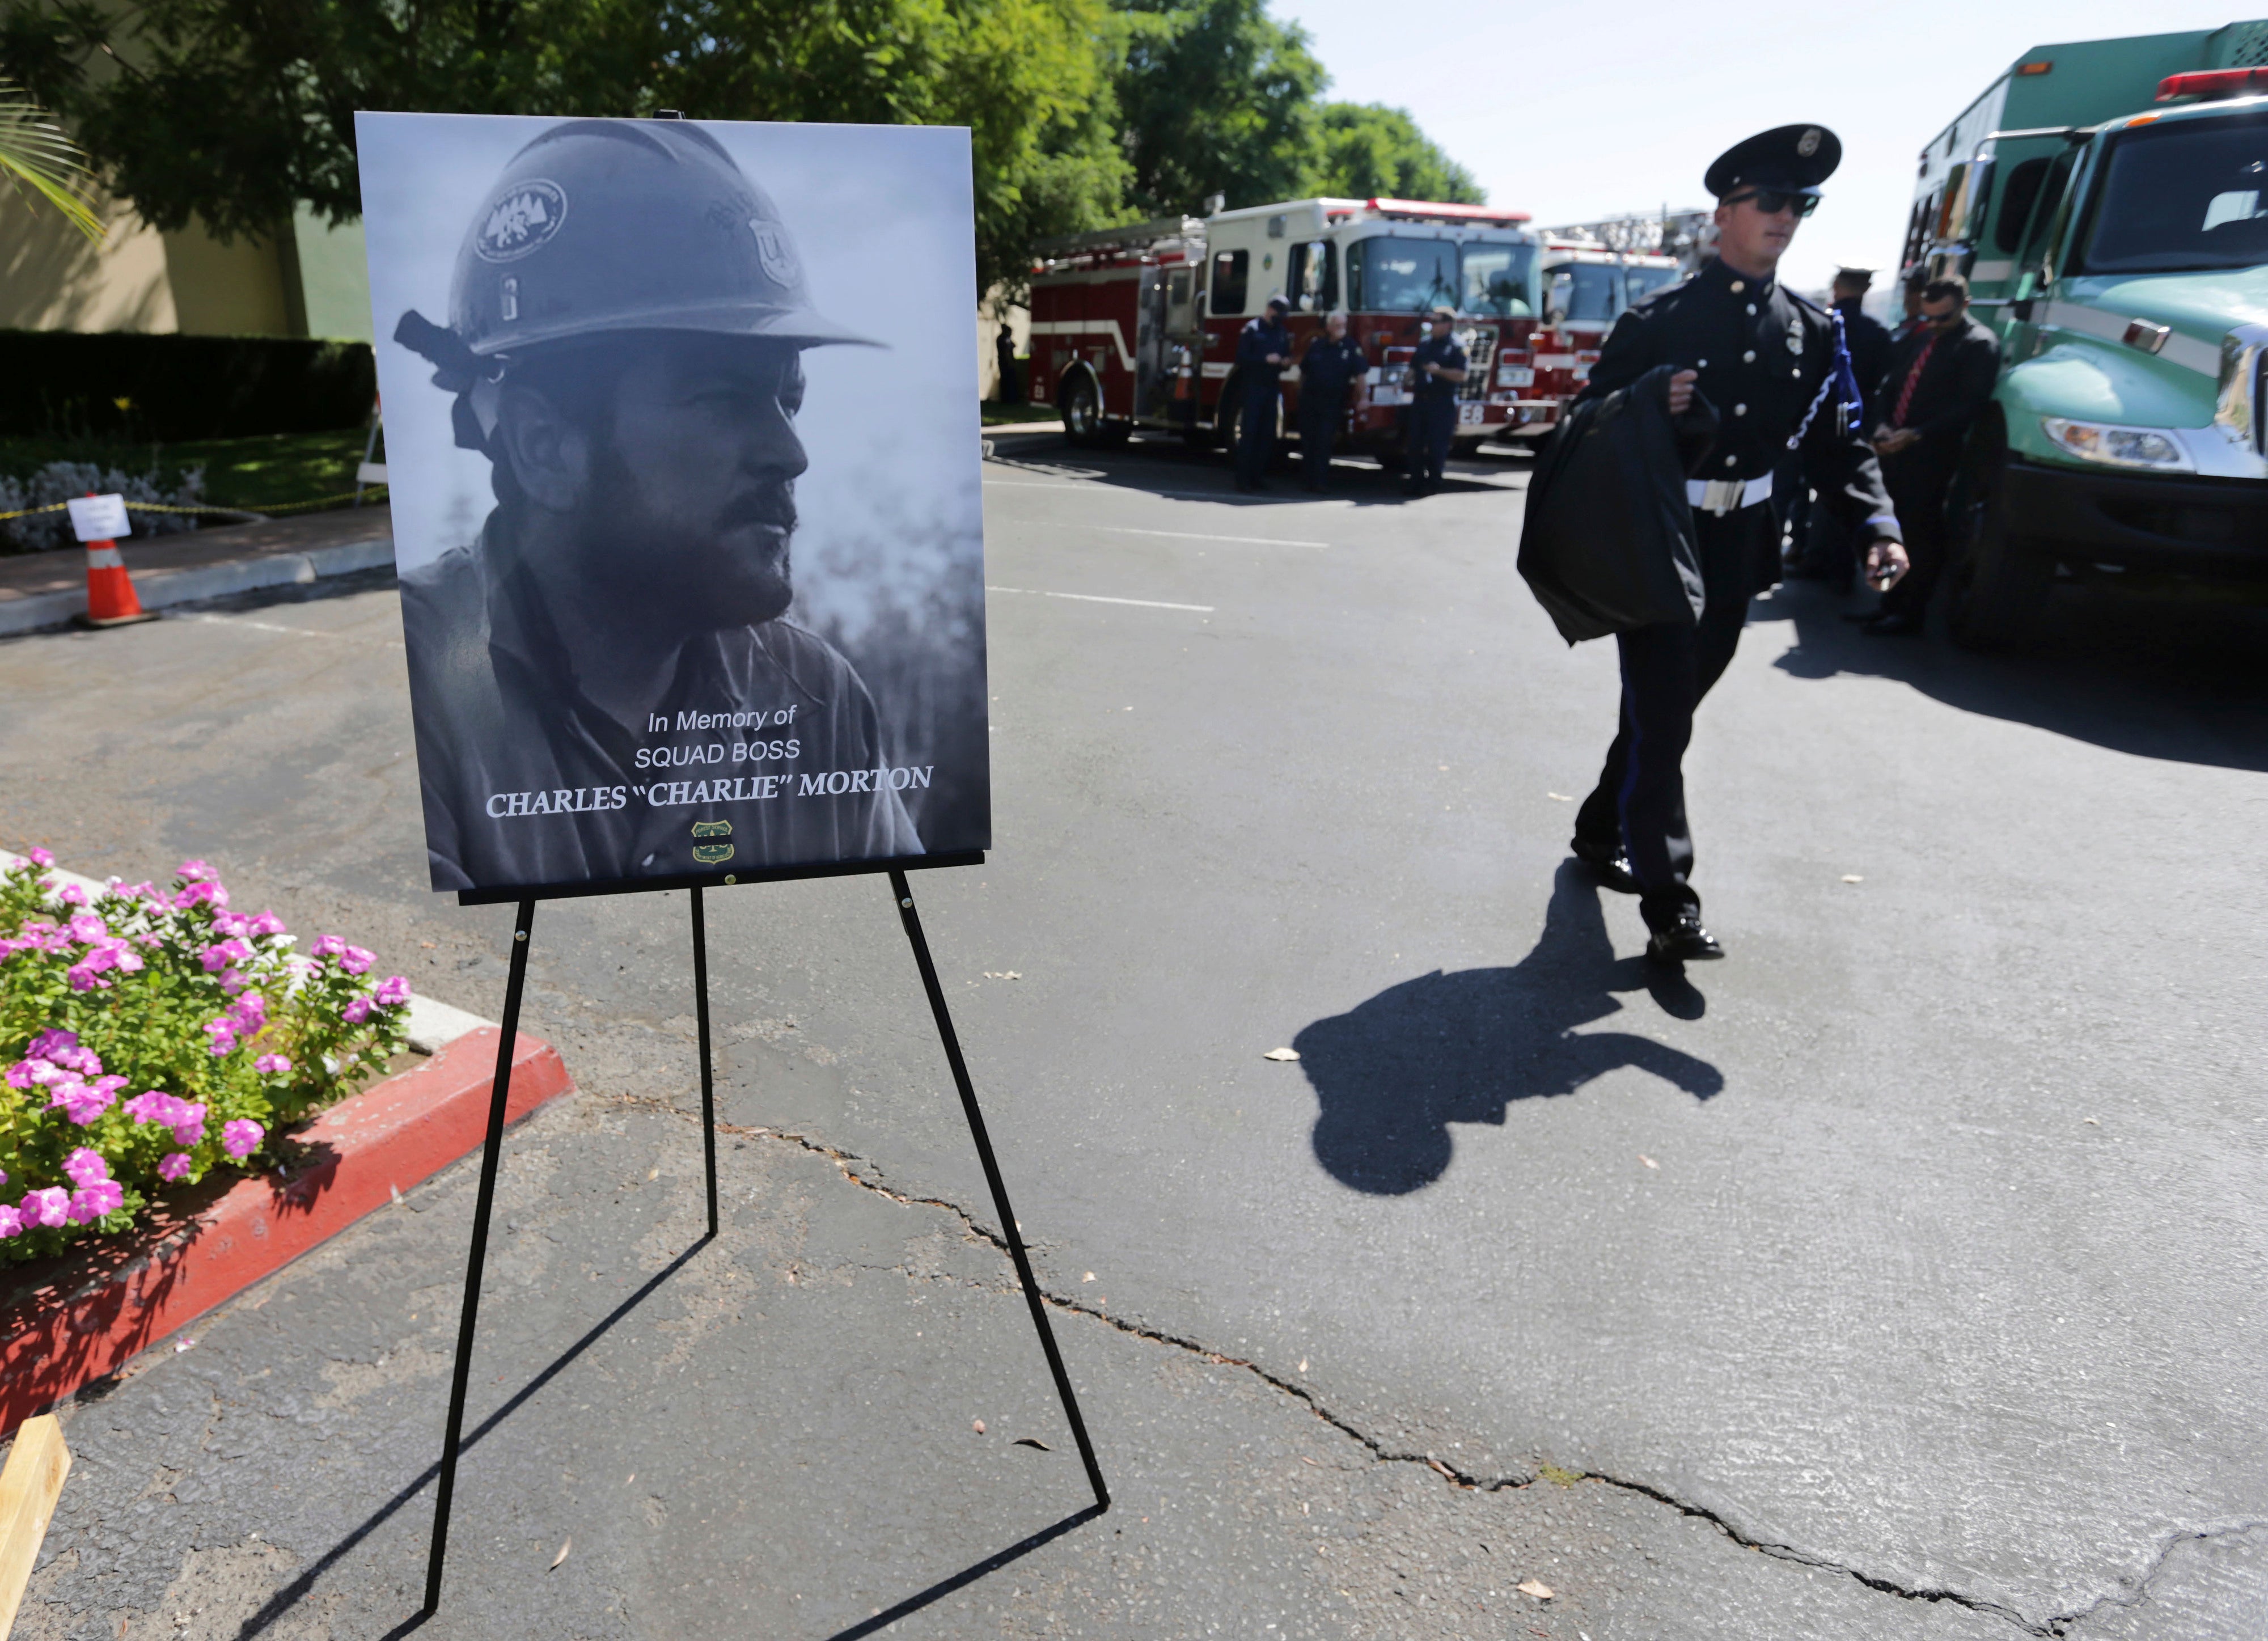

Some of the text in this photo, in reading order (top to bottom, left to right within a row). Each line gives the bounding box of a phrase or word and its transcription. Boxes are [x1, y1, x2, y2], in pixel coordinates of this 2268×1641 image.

[648, 704, 798, 732] In Memory of
[634, 739, 801, 768] SQUAD BOSS
[486, 785, 627, 818] CHARLES
[797, 765, 934, 796] MORTON
